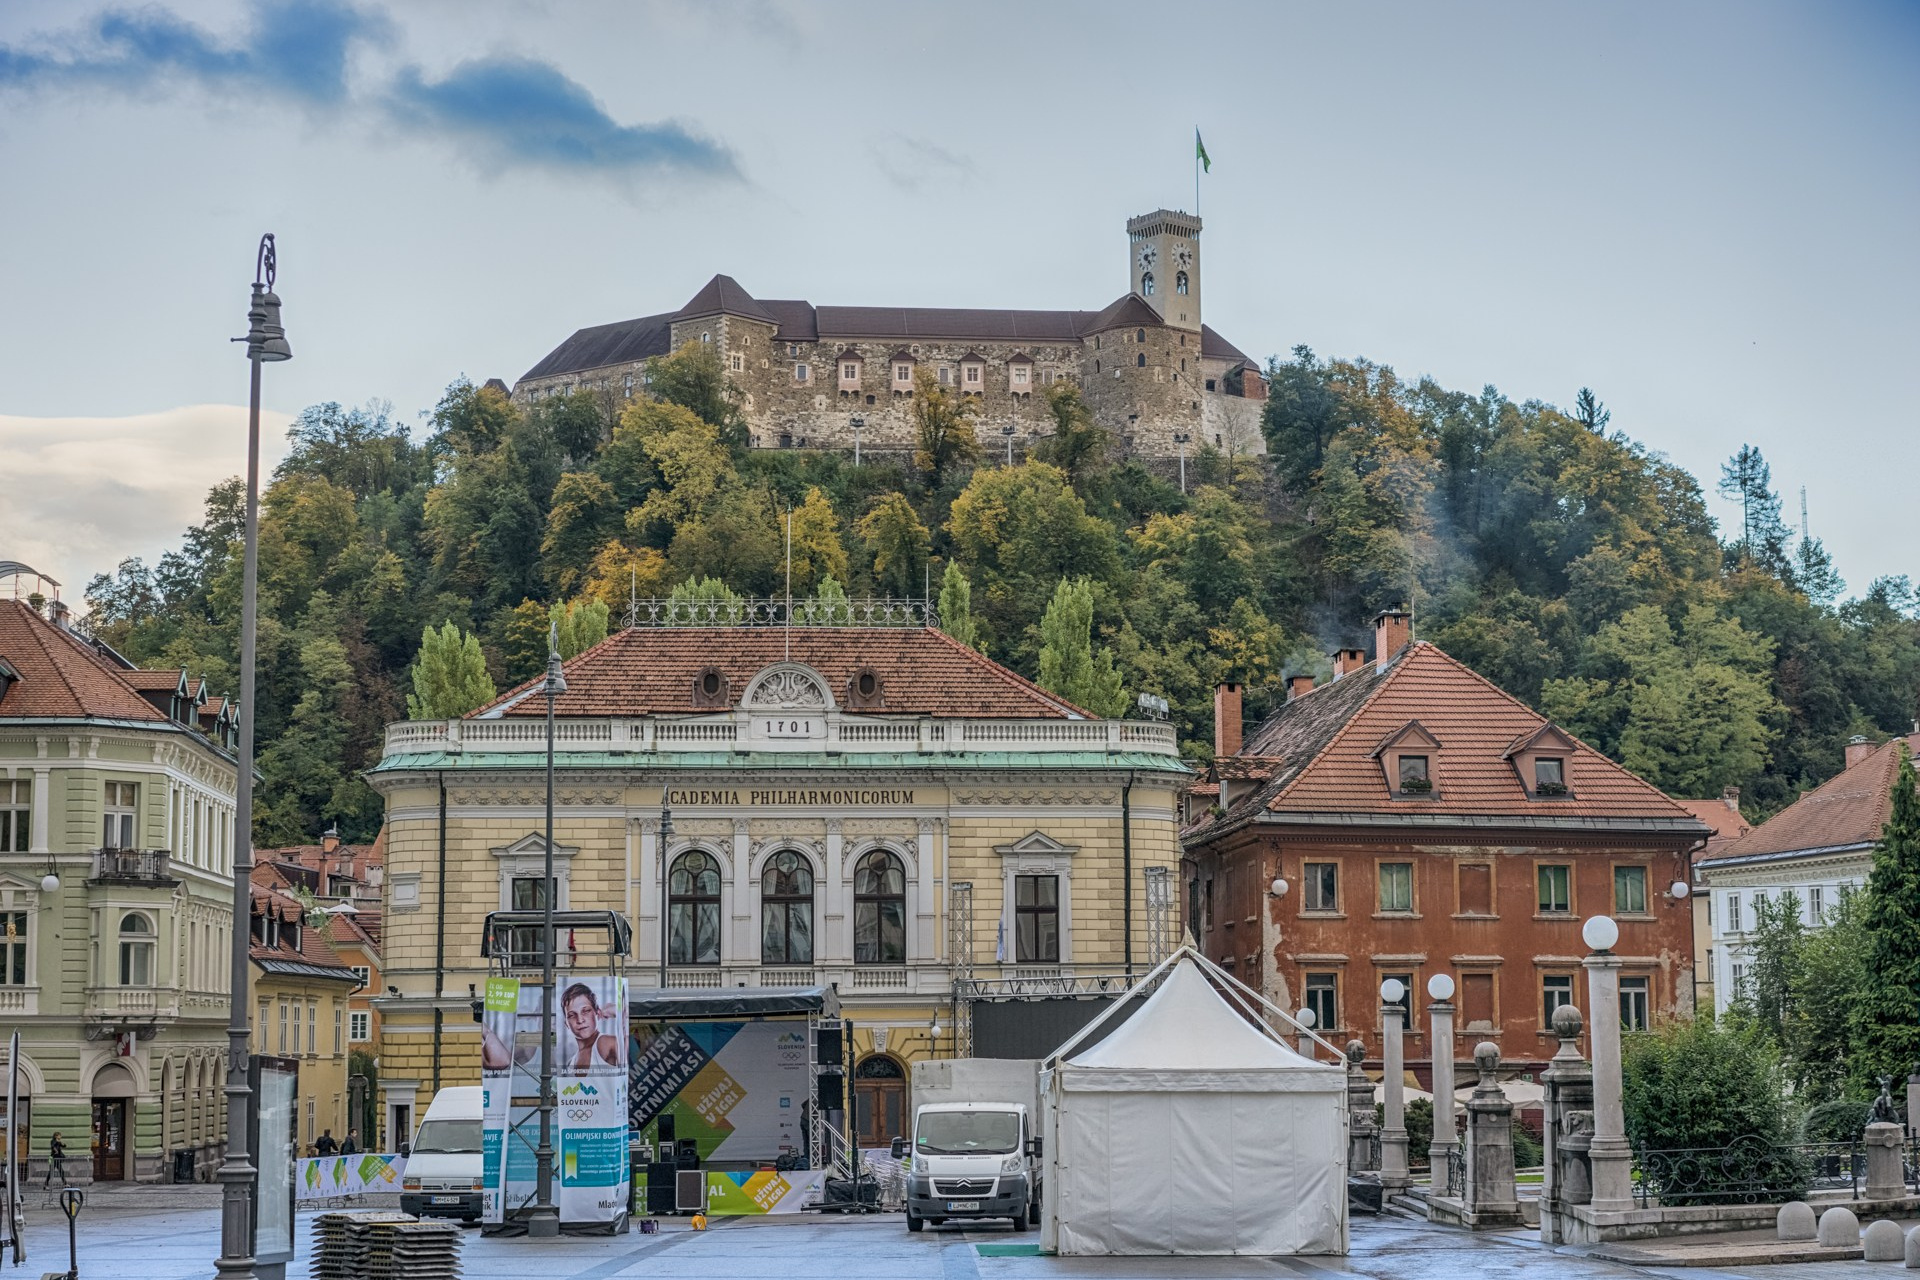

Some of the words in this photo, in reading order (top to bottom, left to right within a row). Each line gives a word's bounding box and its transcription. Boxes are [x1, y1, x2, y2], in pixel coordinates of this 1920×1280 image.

[766, 721, 809, 733] 1701
[751, 790, 914, 804] PHILHARMONICORUM
[679, 1039, 691, 1052] S
[681, 1050, 704, 1077] ASI
[696, 1077, 733, 1114] UŽIVAJ
[706, 1111, 716, 1123] V
[715, 1090, 739, 1115] IGRI
[565, 1131, 601, 1141] OLIMPIJSKI
[761, 1201, 769, 1210] V
[768, 1185, 785, 1203] IGRI
